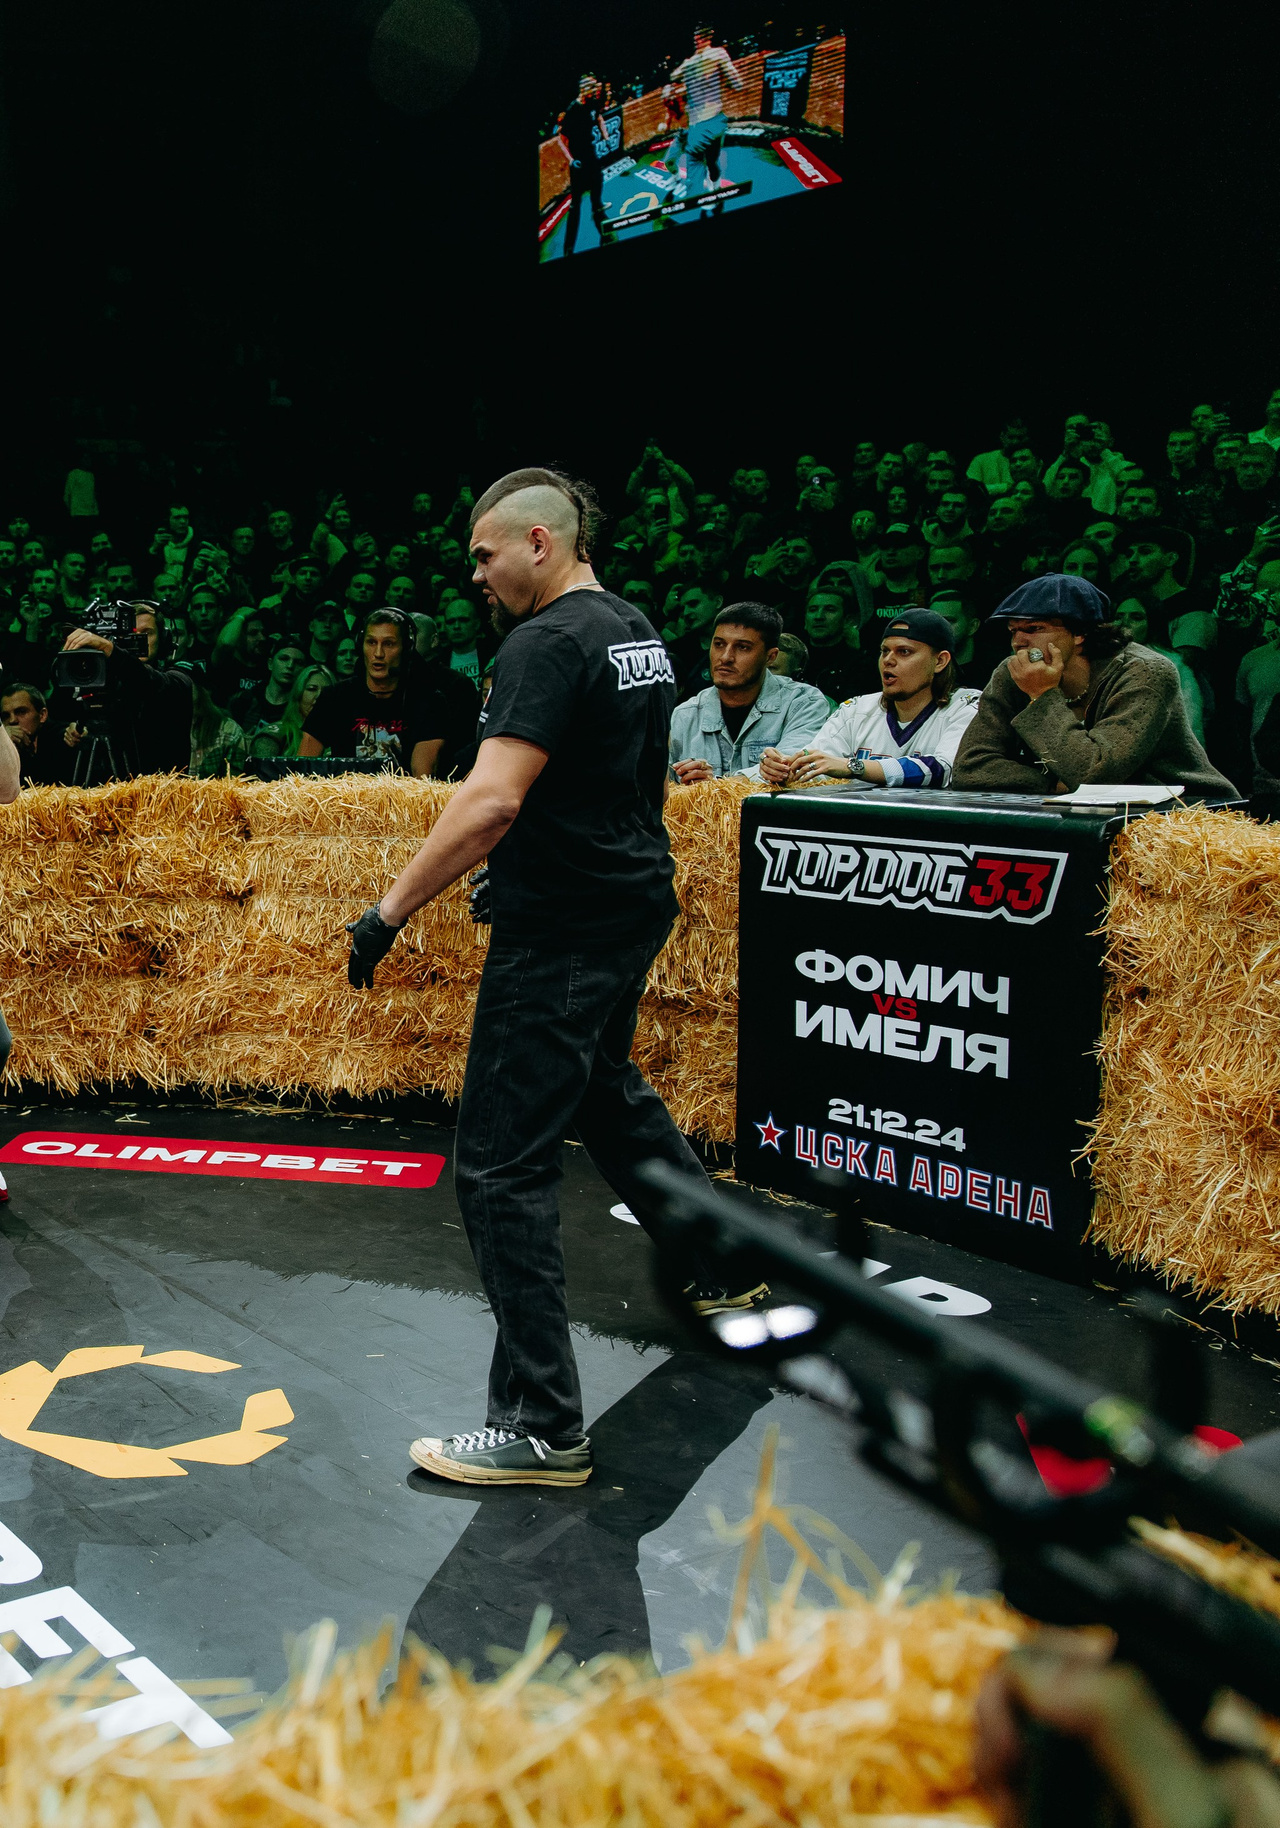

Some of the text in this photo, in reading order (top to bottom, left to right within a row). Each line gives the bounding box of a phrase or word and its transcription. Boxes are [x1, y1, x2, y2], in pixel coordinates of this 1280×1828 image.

[795, 949, 1010, 1015] ФОМИЧ
[872, 993, 918, 1020] VS
[795, 1000, 1010, 1079] ИМЕЛЯ
[828, 1098, 966, 1152] 21.12.24
[22, 1141, 422, 1176] OLIMPBET
[795, 1124, 1054, 1231] ЦСКА АРЕНА
